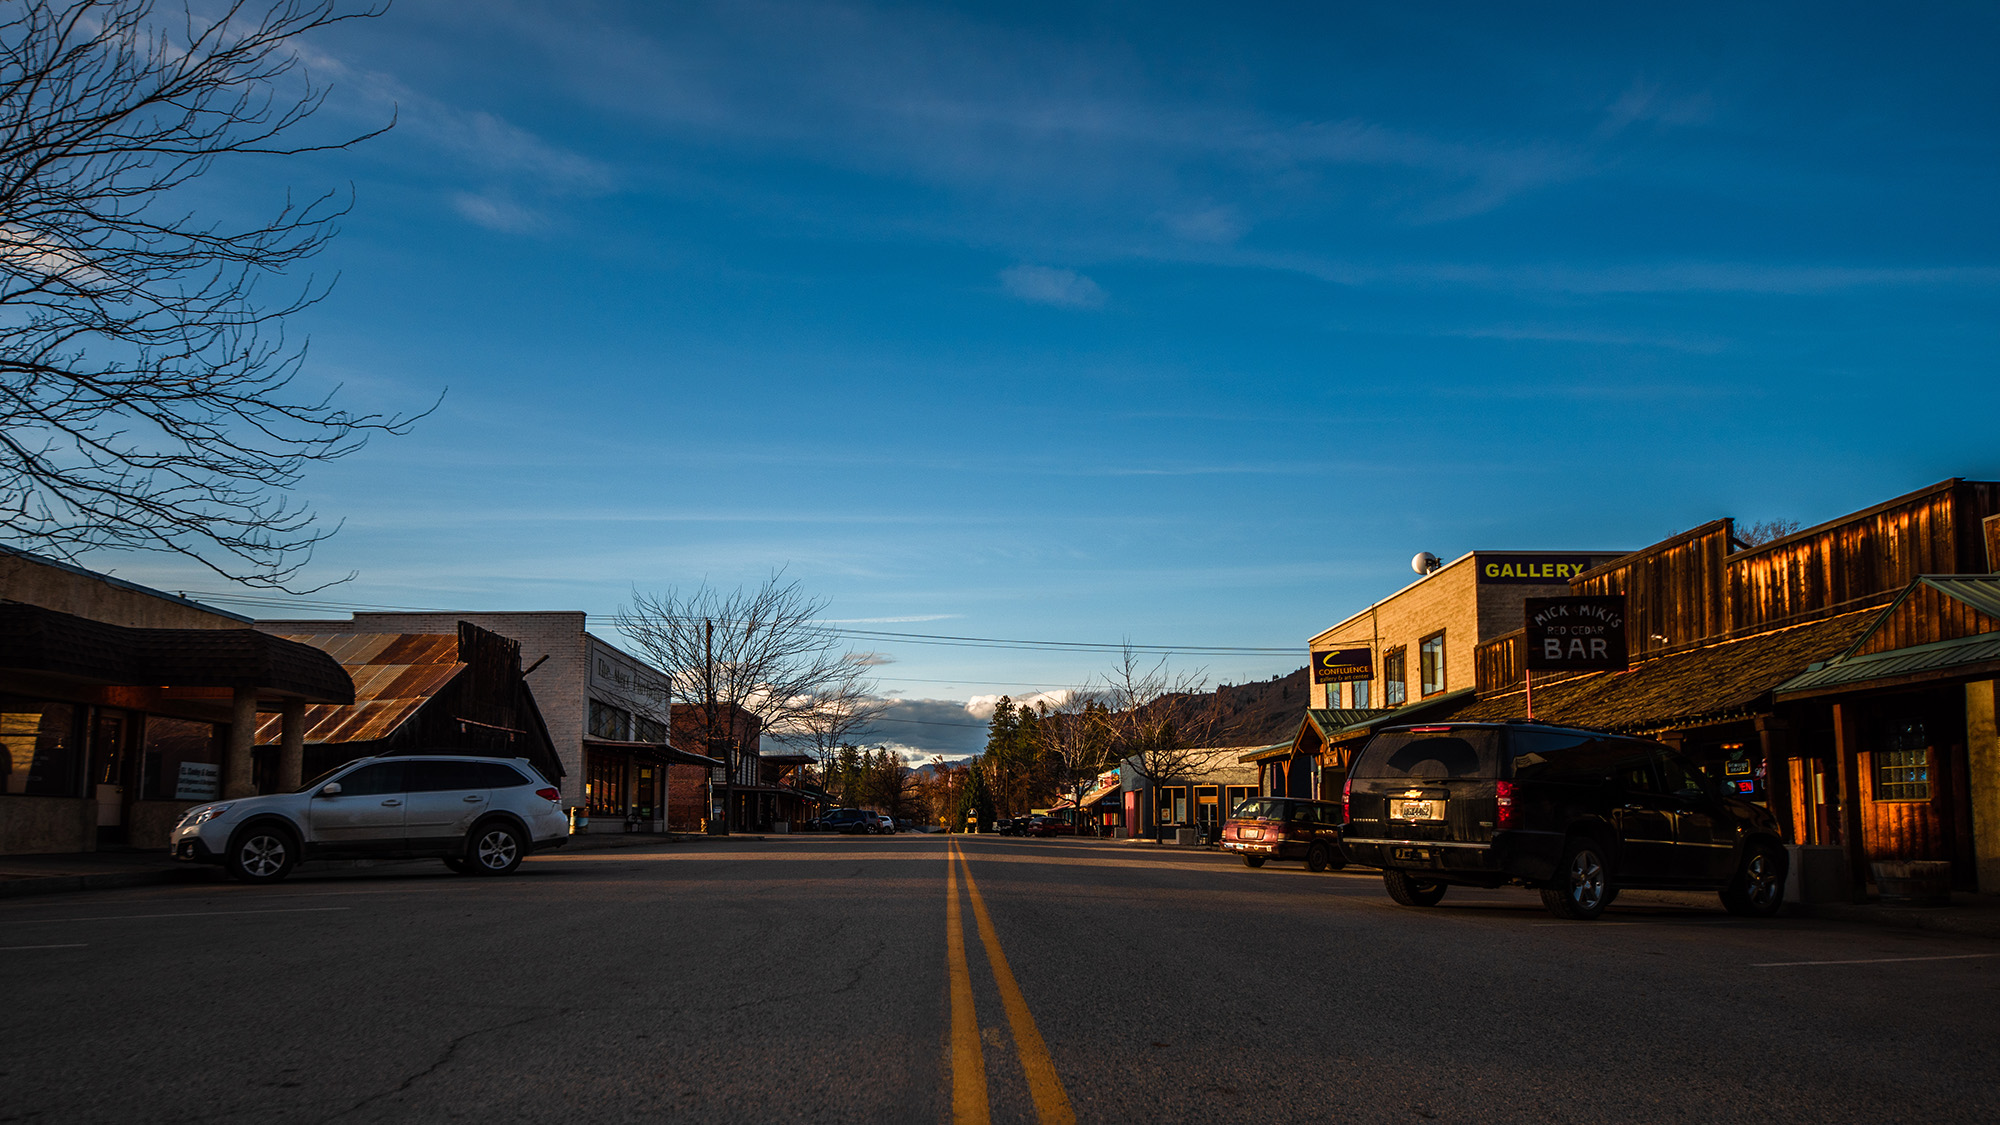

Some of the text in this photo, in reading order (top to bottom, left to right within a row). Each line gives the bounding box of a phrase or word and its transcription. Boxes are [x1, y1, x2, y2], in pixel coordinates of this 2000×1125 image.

[1485, 563, 1584, 578] GALLERY
[1534, 604, 1570, 627] MICK
[1579, 604, 1623, 628] MIKI'S
[1547, 625, 1605, 636] RED CEDAR
[1544, 638, 1609, 660] BAR
[1318, 665, 1369, 676] CONFLUENCE
